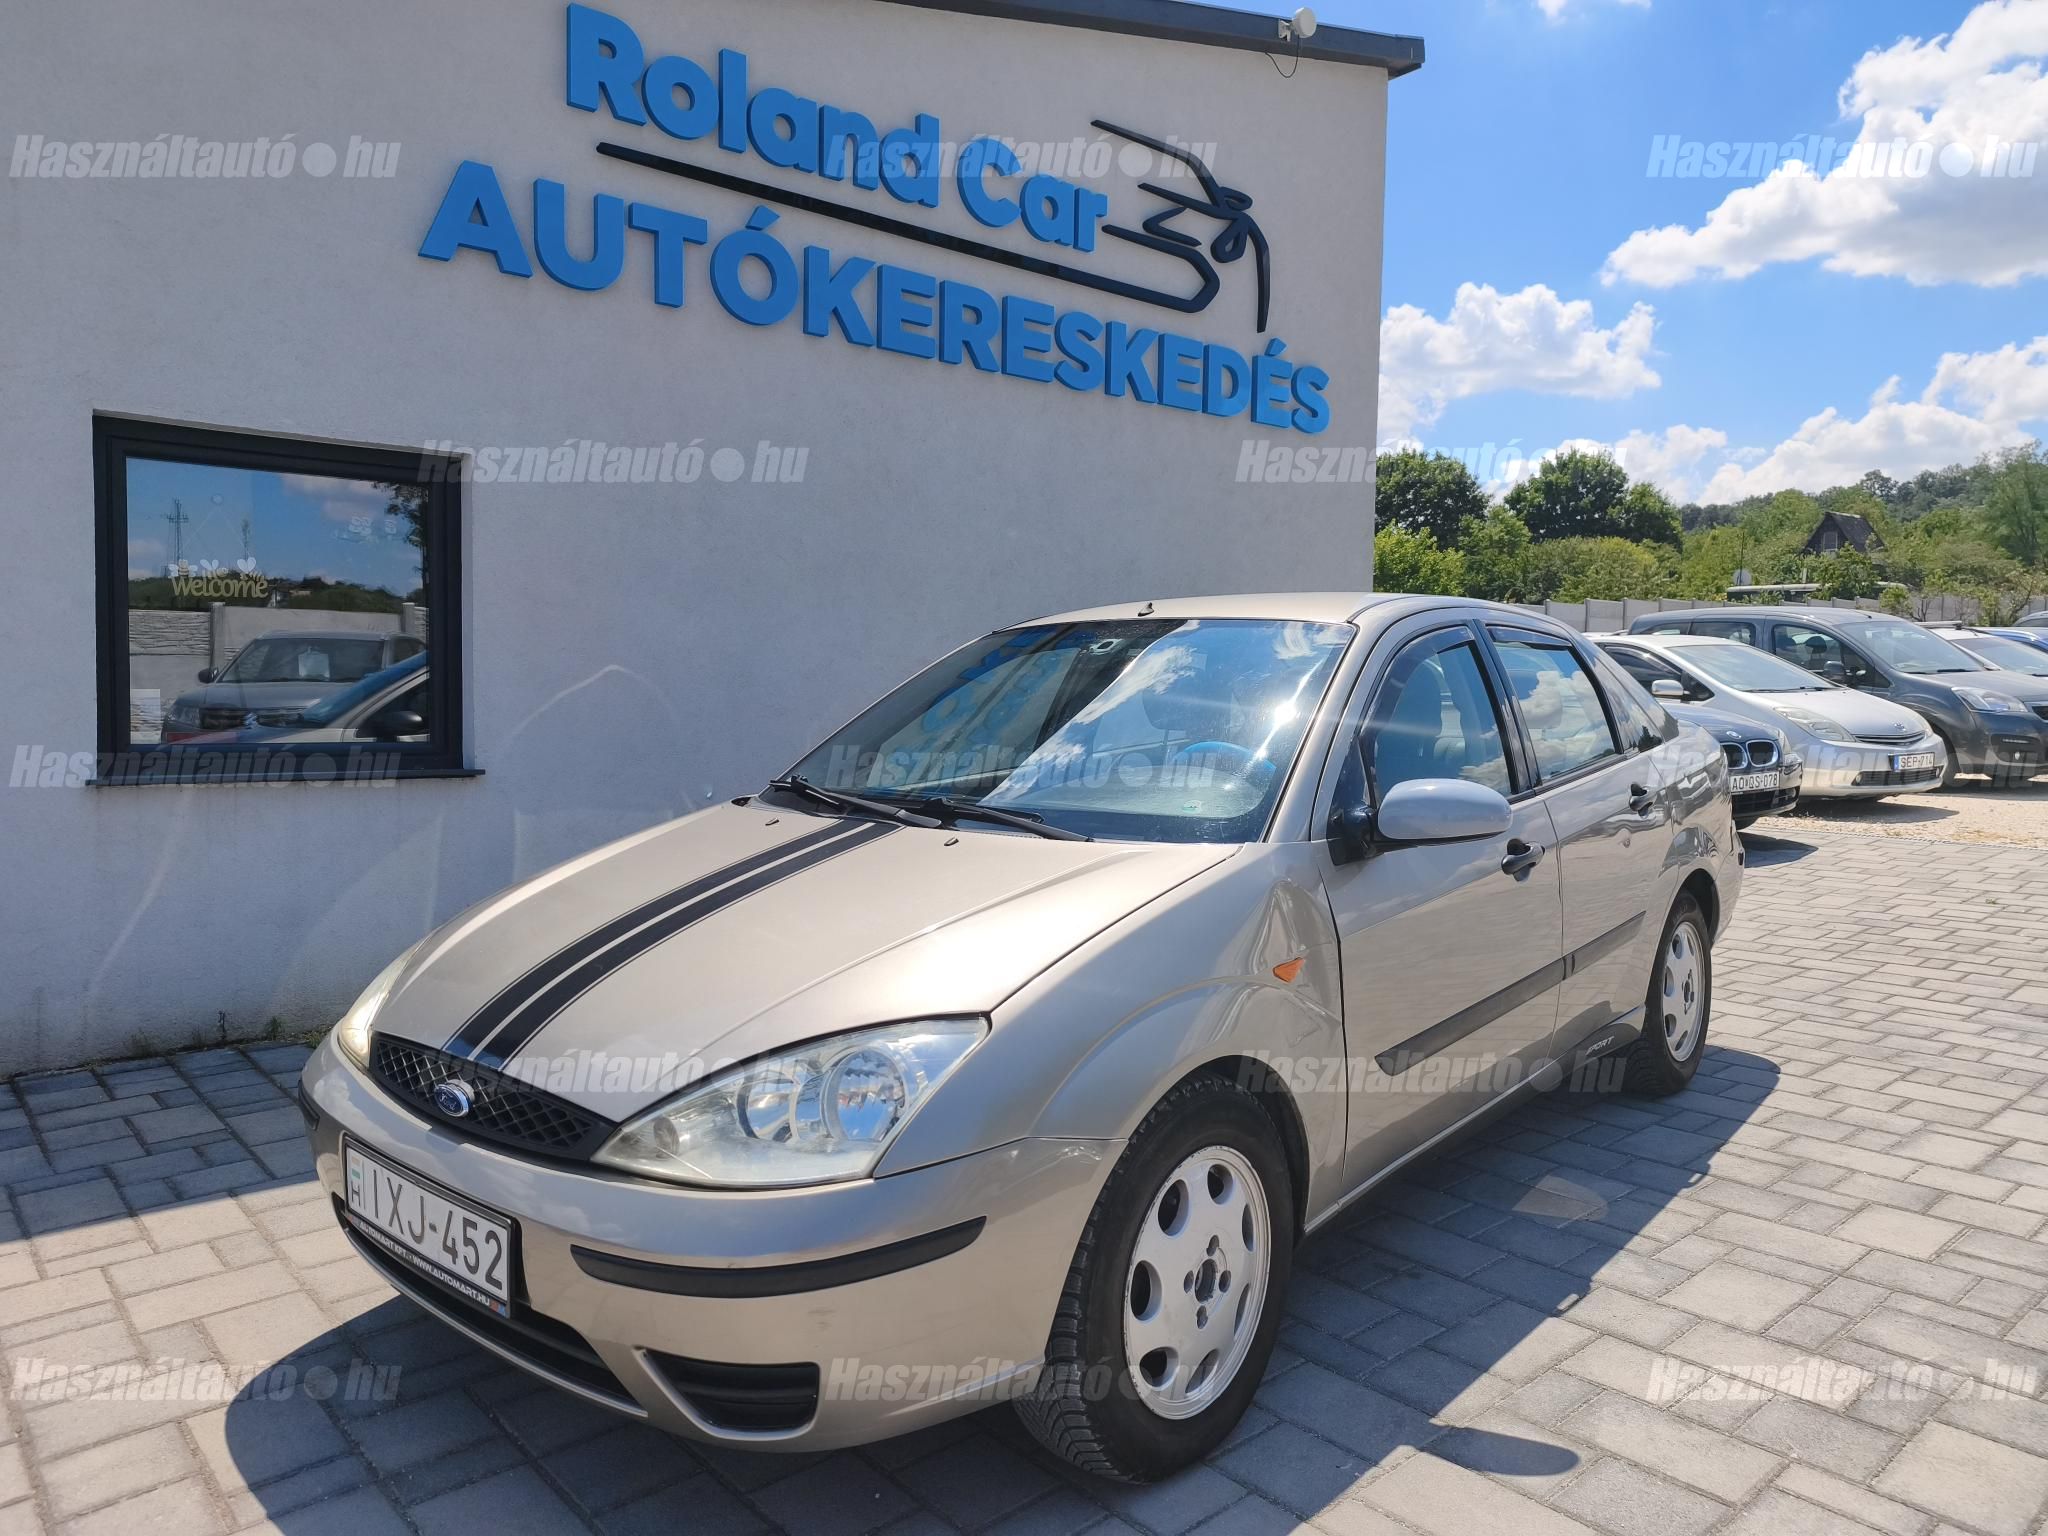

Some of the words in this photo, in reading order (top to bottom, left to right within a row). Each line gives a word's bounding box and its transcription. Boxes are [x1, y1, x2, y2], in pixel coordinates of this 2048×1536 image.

[566, 3, 940, 208] Roland
[957, 137, 1108, 253] Car
[417, 160, 1330, 433] AUTÓKERESKEDÉS
[373, 1168, 503, 1291] IXJ-452
[412, 1256, 491, 1307] WWW.AUTOMART.HU
